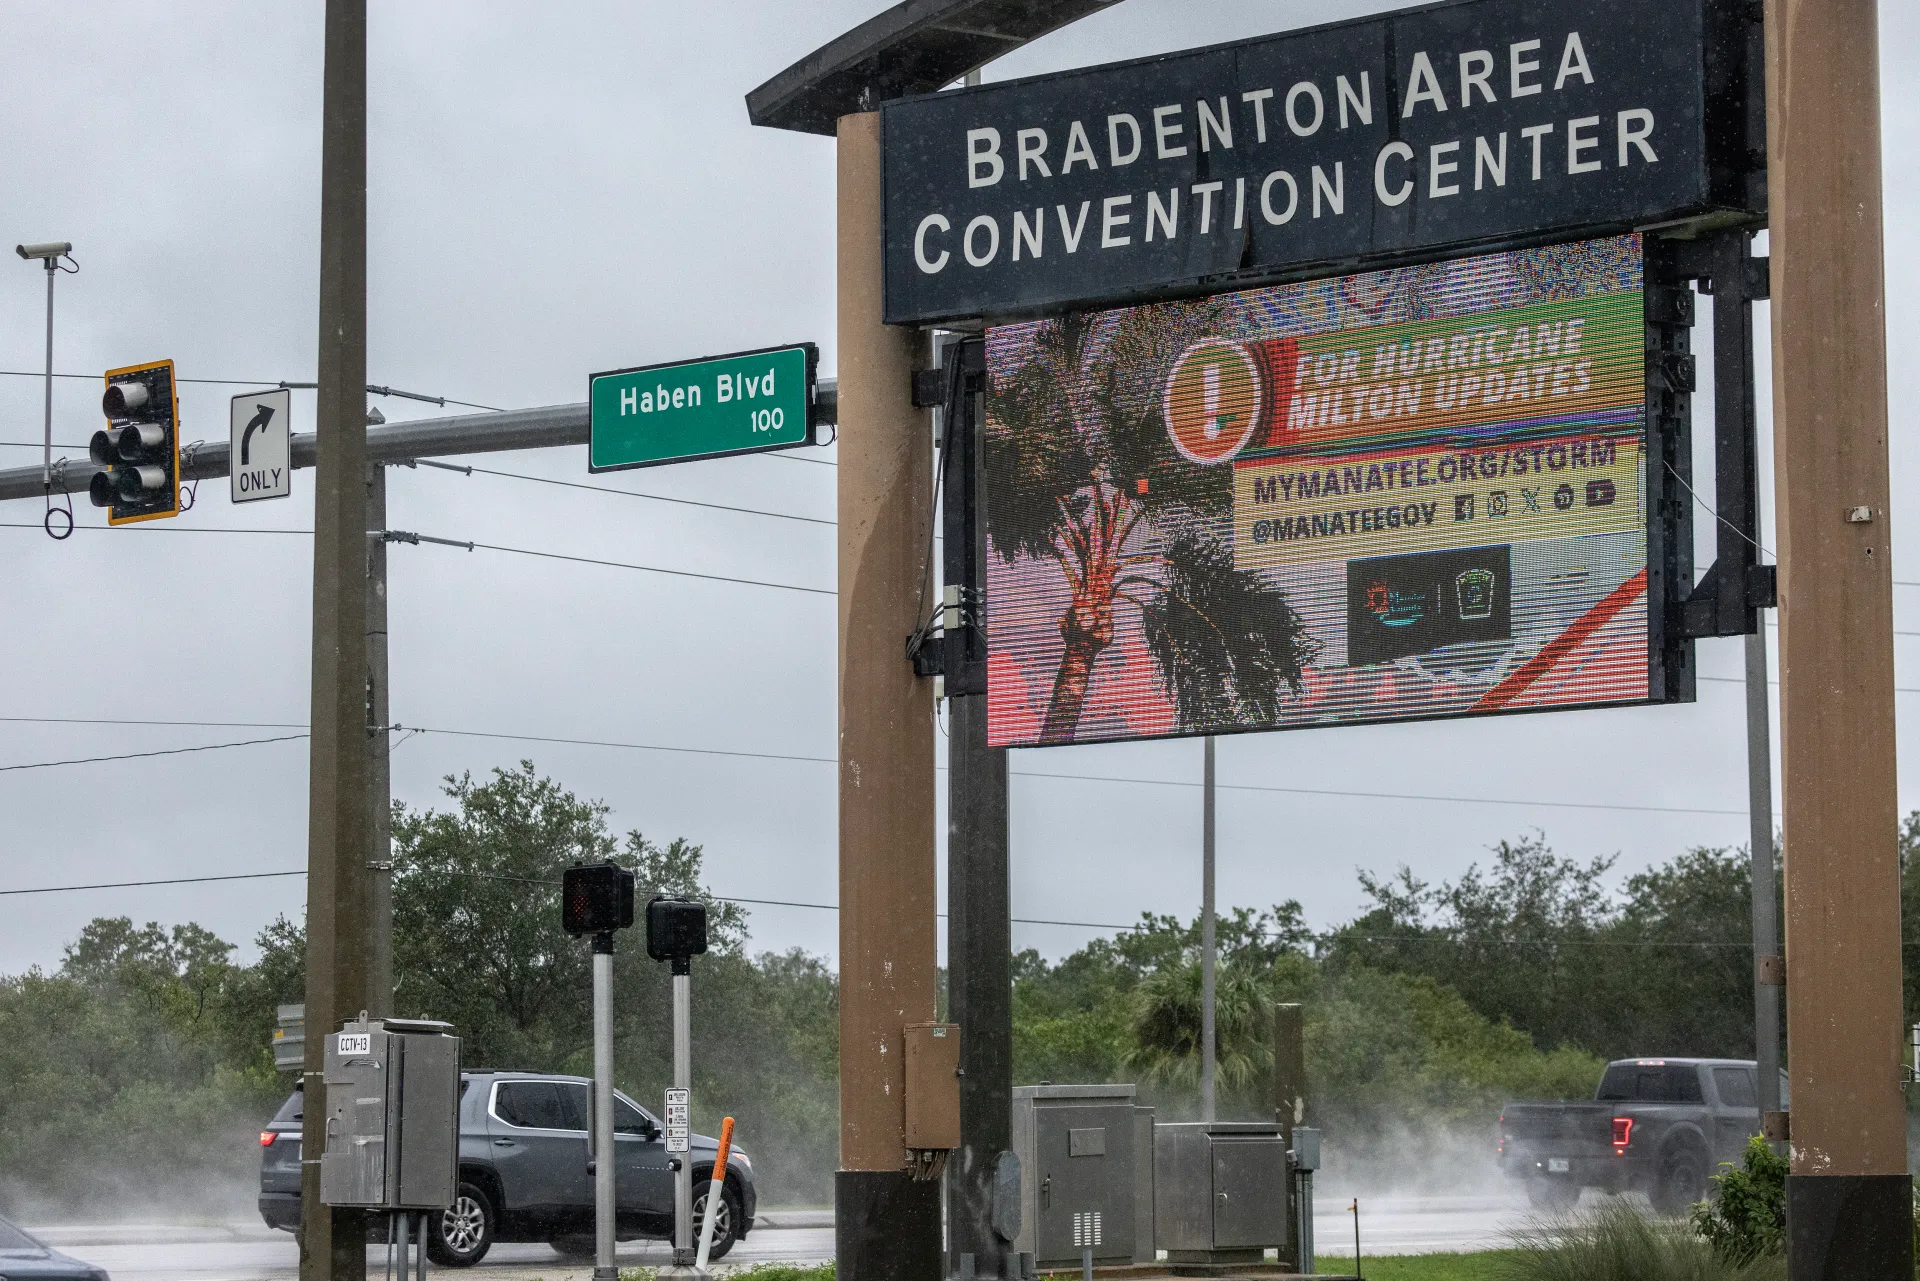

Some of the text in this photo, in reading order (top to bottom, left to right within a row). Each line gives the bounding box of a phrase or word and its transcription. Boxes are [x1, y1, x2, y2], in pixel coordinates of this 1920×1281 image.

[967, 32, 1594, 189] BRADENTON AREA
[913, 108, 1659, 274] CONVENTION CENTER
[1295, 317, 1586, 388] FOR HURRICANE
[620, 368, 775, 416] Haben Blvd
[751, 407, 784, 432] 100
[1287, 357, 1593, 429] MILTON UPDATES
[240, 467, 281, 492] ONLY
[1254, 438, 1617, 503] MYMANATEE.ORG/STORM
[1252, 501, 1438, 543] @MANATEEGOV
[340, 1037, 367, 1051] CCTV-13
